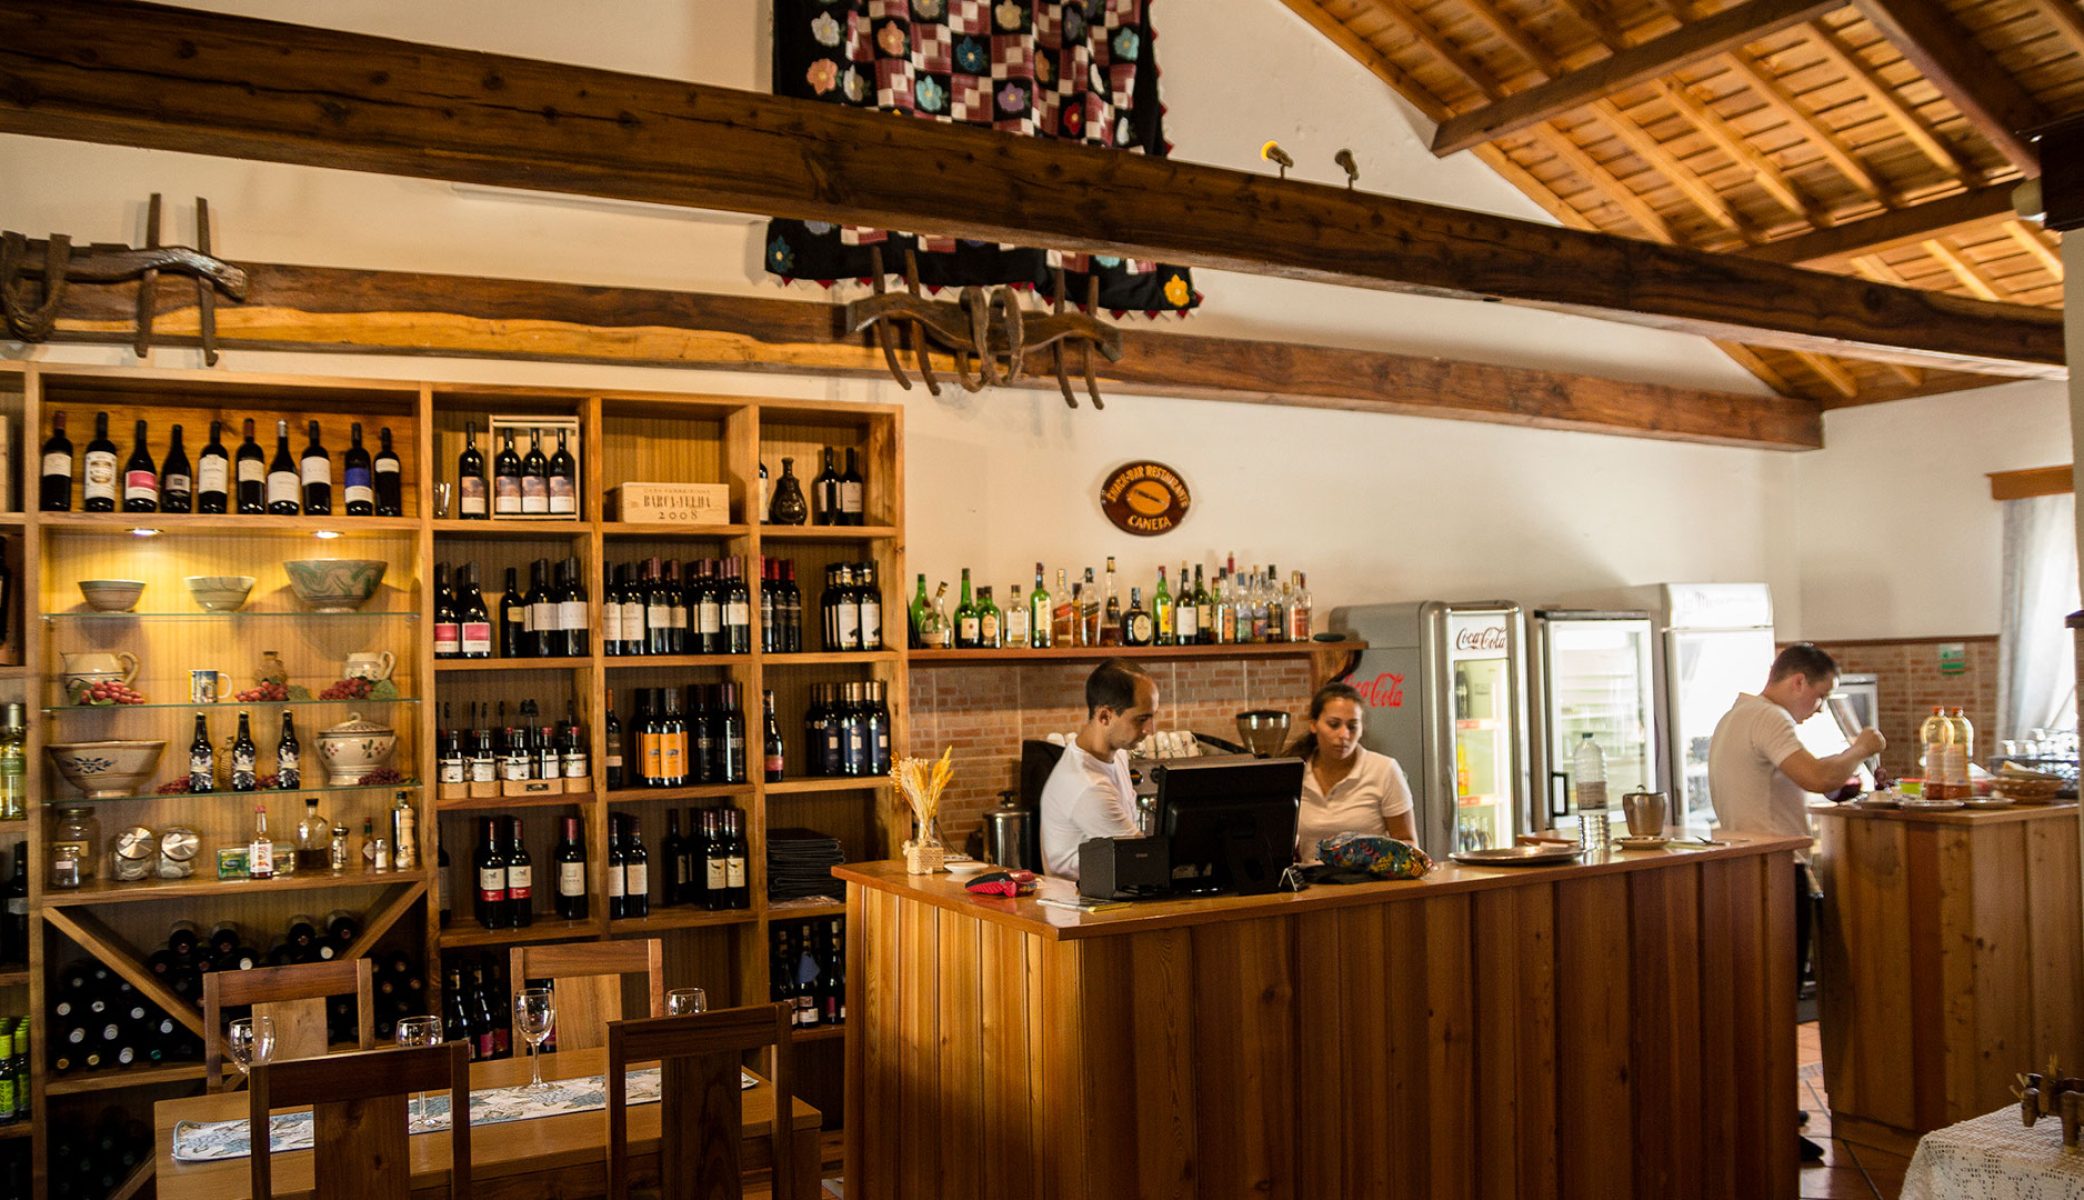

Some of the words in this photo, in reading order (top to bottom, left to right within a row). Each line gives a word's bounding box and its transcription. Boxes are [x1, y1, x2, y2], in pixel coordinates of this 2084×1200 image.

[1145, 465, 1188, 508] RESTAURANTE
[657, 510, 698, 520] 2008
[1127, 515, 1172, 530] CANETA
